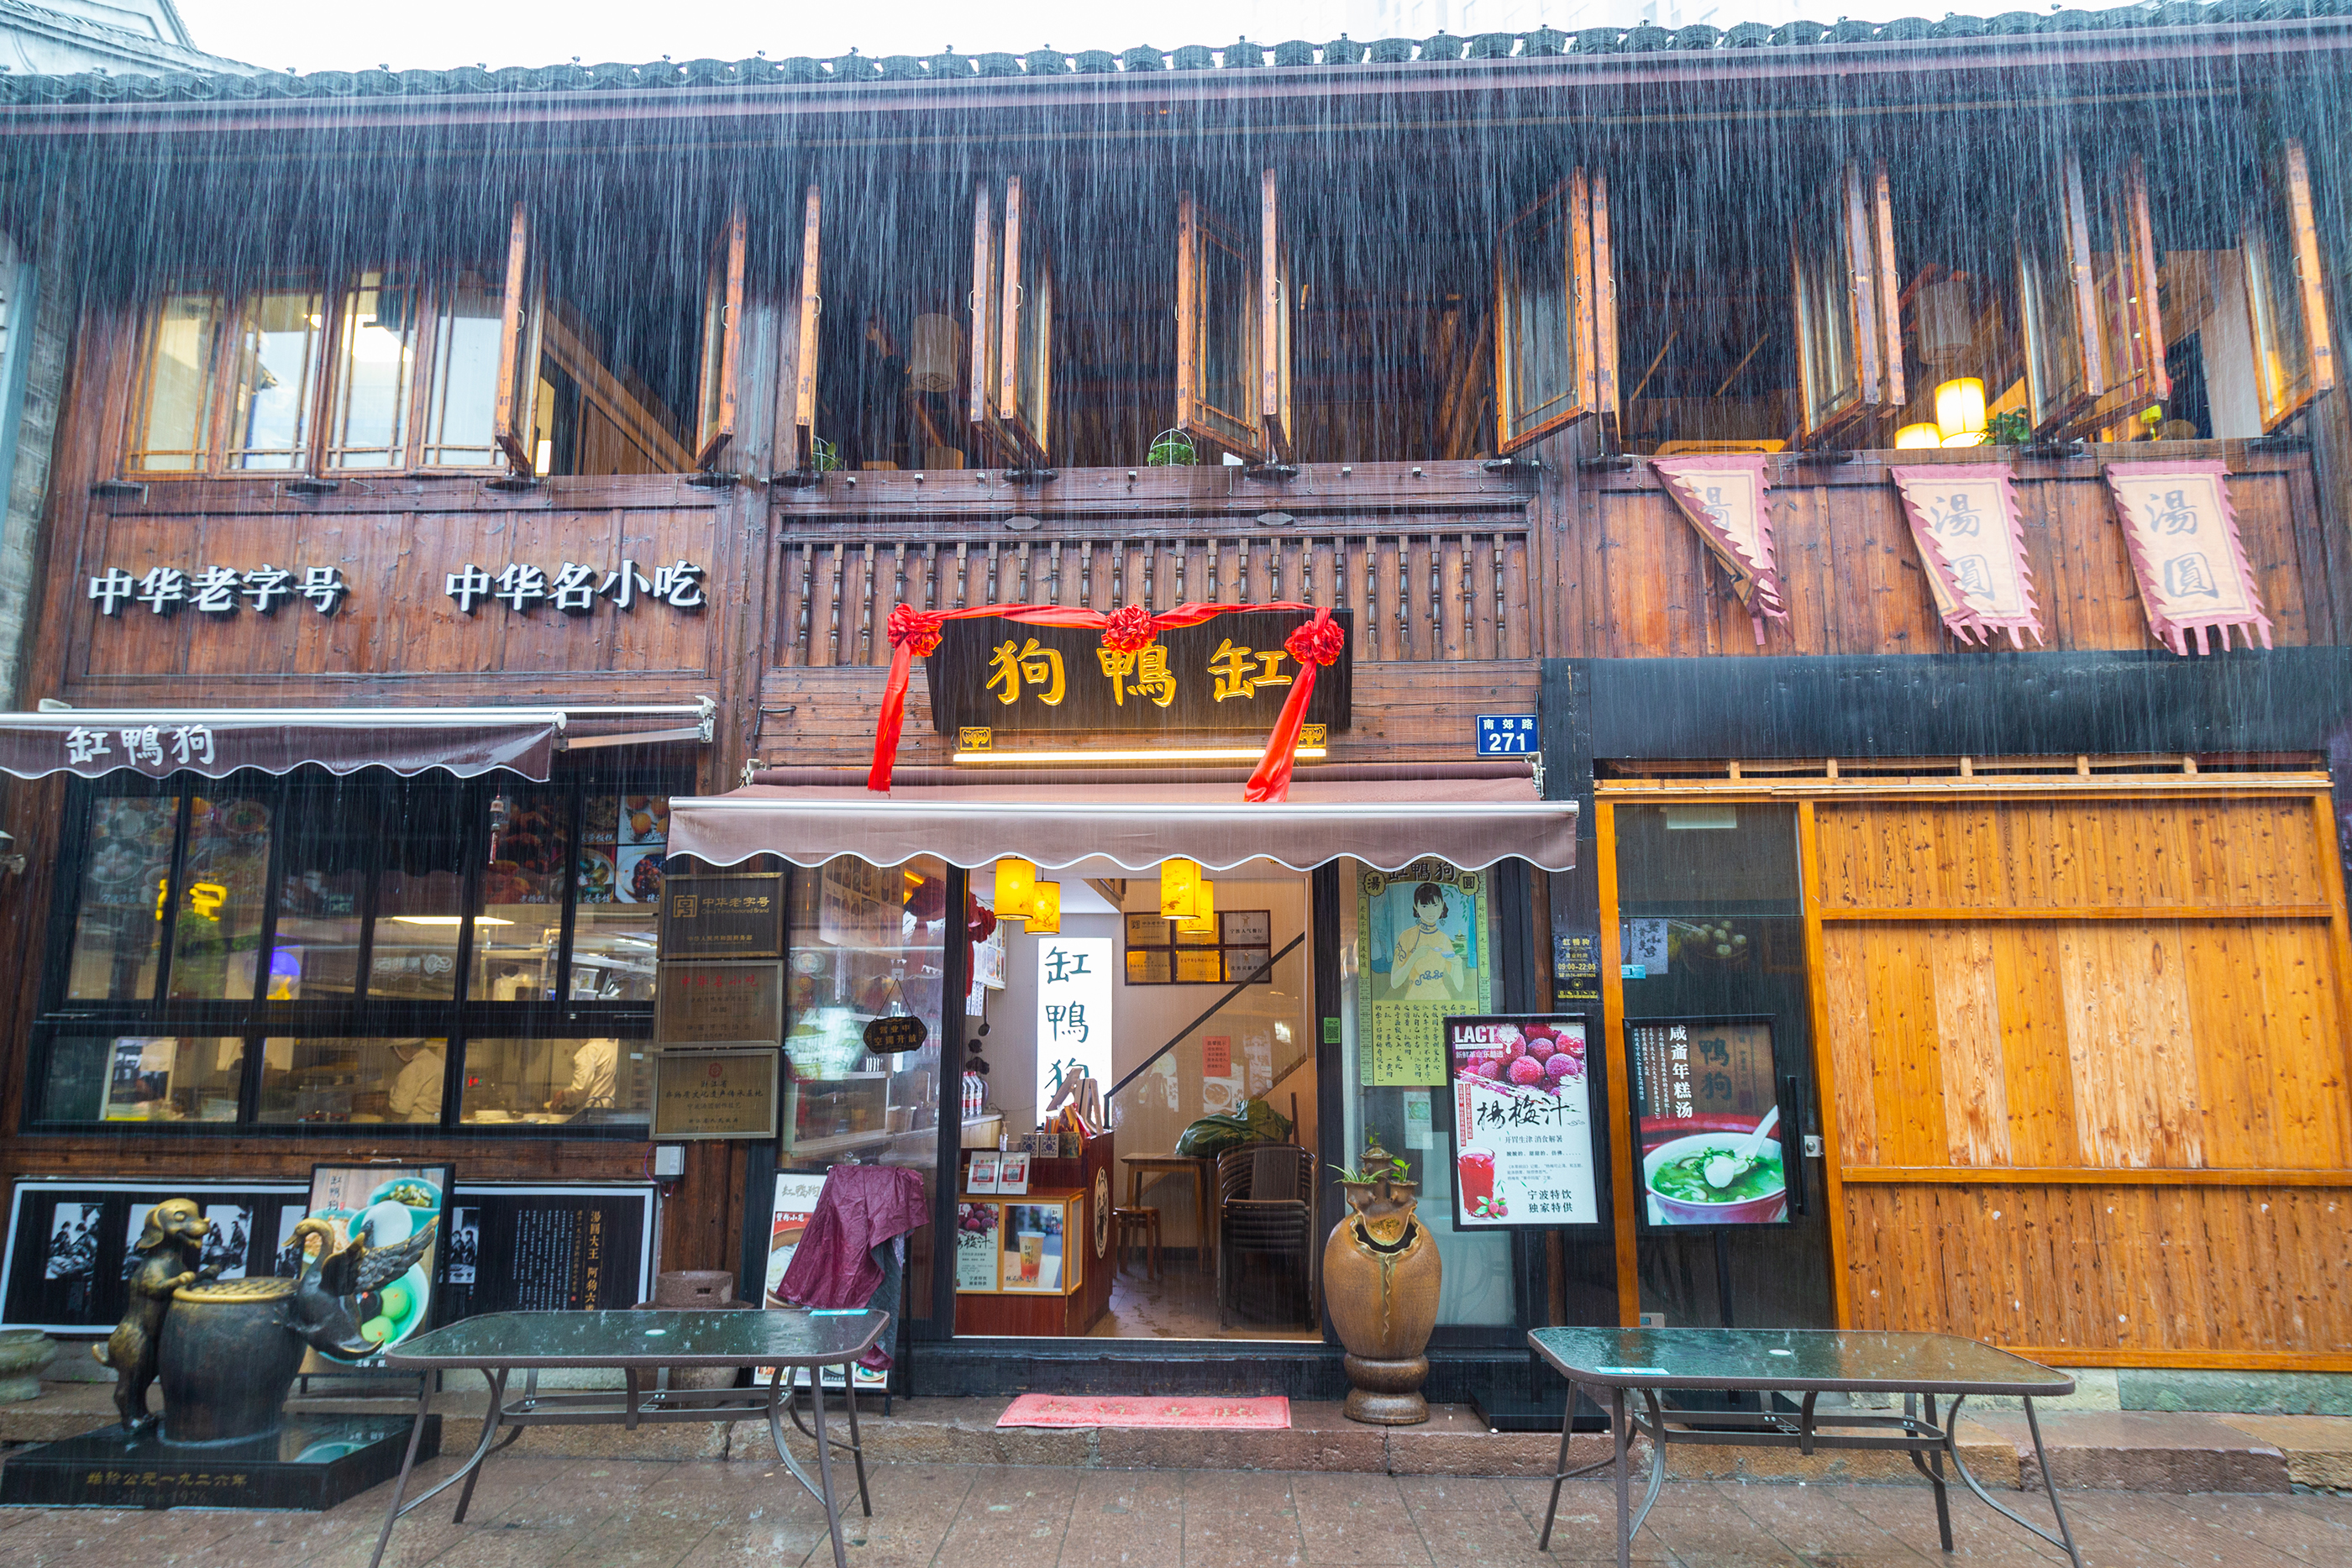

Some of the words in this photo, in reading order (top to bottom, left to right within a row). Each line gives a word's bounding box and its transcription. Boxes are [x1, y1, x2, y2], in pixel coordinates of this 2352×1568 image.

[2145, 490, 2220, 600] 湯圓
[87, 565, 344, 616] 中华老字号
[446, 559, 704, 614] 中华名小吃
[1483, 718, 1533, 730] 南郊路
[1488, 732, 1525, 752] 271
[1368, 876, 1381, 890] 湯
[1463, 876, 1476, 889] 圓
[701, 896, 770, 908] 中华老字号
[681, 974, 759, 988] 中华名小吃
[879, 1024, 910, 1034] 营业中
[874, 1034, 917, 1046] 空调开放
[1527, 1189, 1572, 1201] 宁波特饮
[1529, 1203, 1572, 1213] 独家特供
[587, 1211, 601, 1260] 湯圓大王
